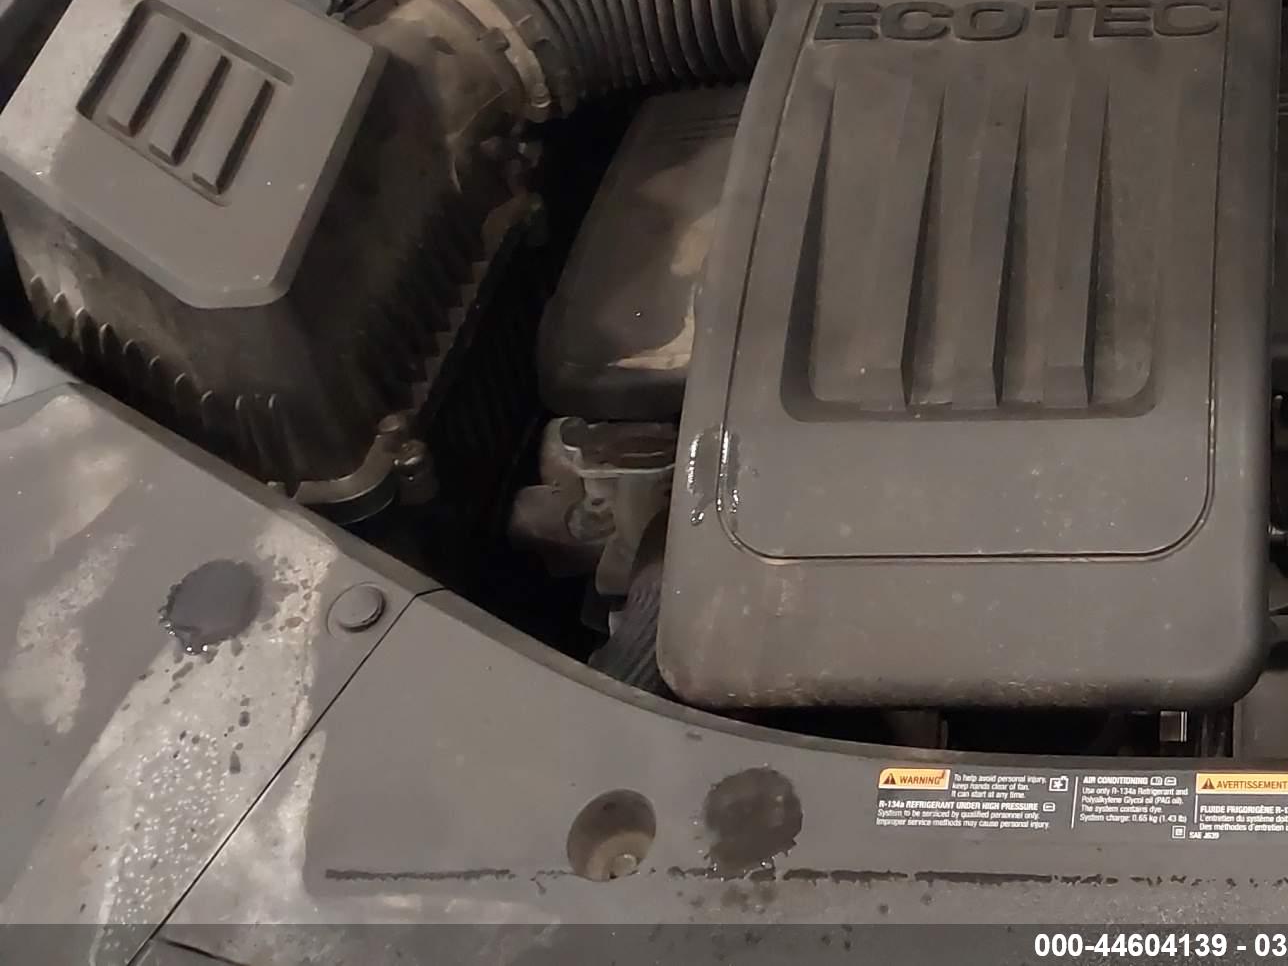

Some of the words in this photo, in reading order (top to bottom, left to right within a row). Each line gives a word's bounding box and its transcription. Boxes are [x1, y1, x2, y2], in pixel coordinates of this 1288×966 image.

[899, 776, 941, 785] WARNING
[954, 774, 961, 782] To
[962, 774, 977, 783] help
[997, 776, 1026, 784] personal
[1082, 776, 1096, 784] AIR
[1097, 776, 1148, 784] CONDITIONING
[952, 782, 968, 790] keep
[1216, 780, 1288, 789] AVERTISSEMENT
[1096, 788, 1110, 796] only
[1138, 788, 1174, 796] Refrigerant
[878, 800, 904, 808] R-134a
[906, 800, 954, 809] REFRIGERANT
[956, 802, 980, 810] UNDER
[982, 802, 1000, 810] HIGH
[1000, 802, 1038, 810] PRESSURE
[1082, 796, 1122, 804] Polyalkylene
[1124, 796, 1144, 805] Glycol
[1095, 805, 1118, 813] system
[1200, 806, 1226, 814] FLUIDE
[878, 809, 902, 818] System
[951, 810, 960, 819] by
[961, 811, 990, 820] qualified
[990, 812, 1023, 820] personnel
[1080, 814, 1104, 822] System
[1149, 815, 1158, 824] kg
[876, 817, 906, 826] Improper
[908, 818, 931, 826] service
[932, 818, 962, 826] methods
[963, 820, 978, 828] may
[1000, 820, 1028, 829] personal
[1246, 815, 1274, 824] système
